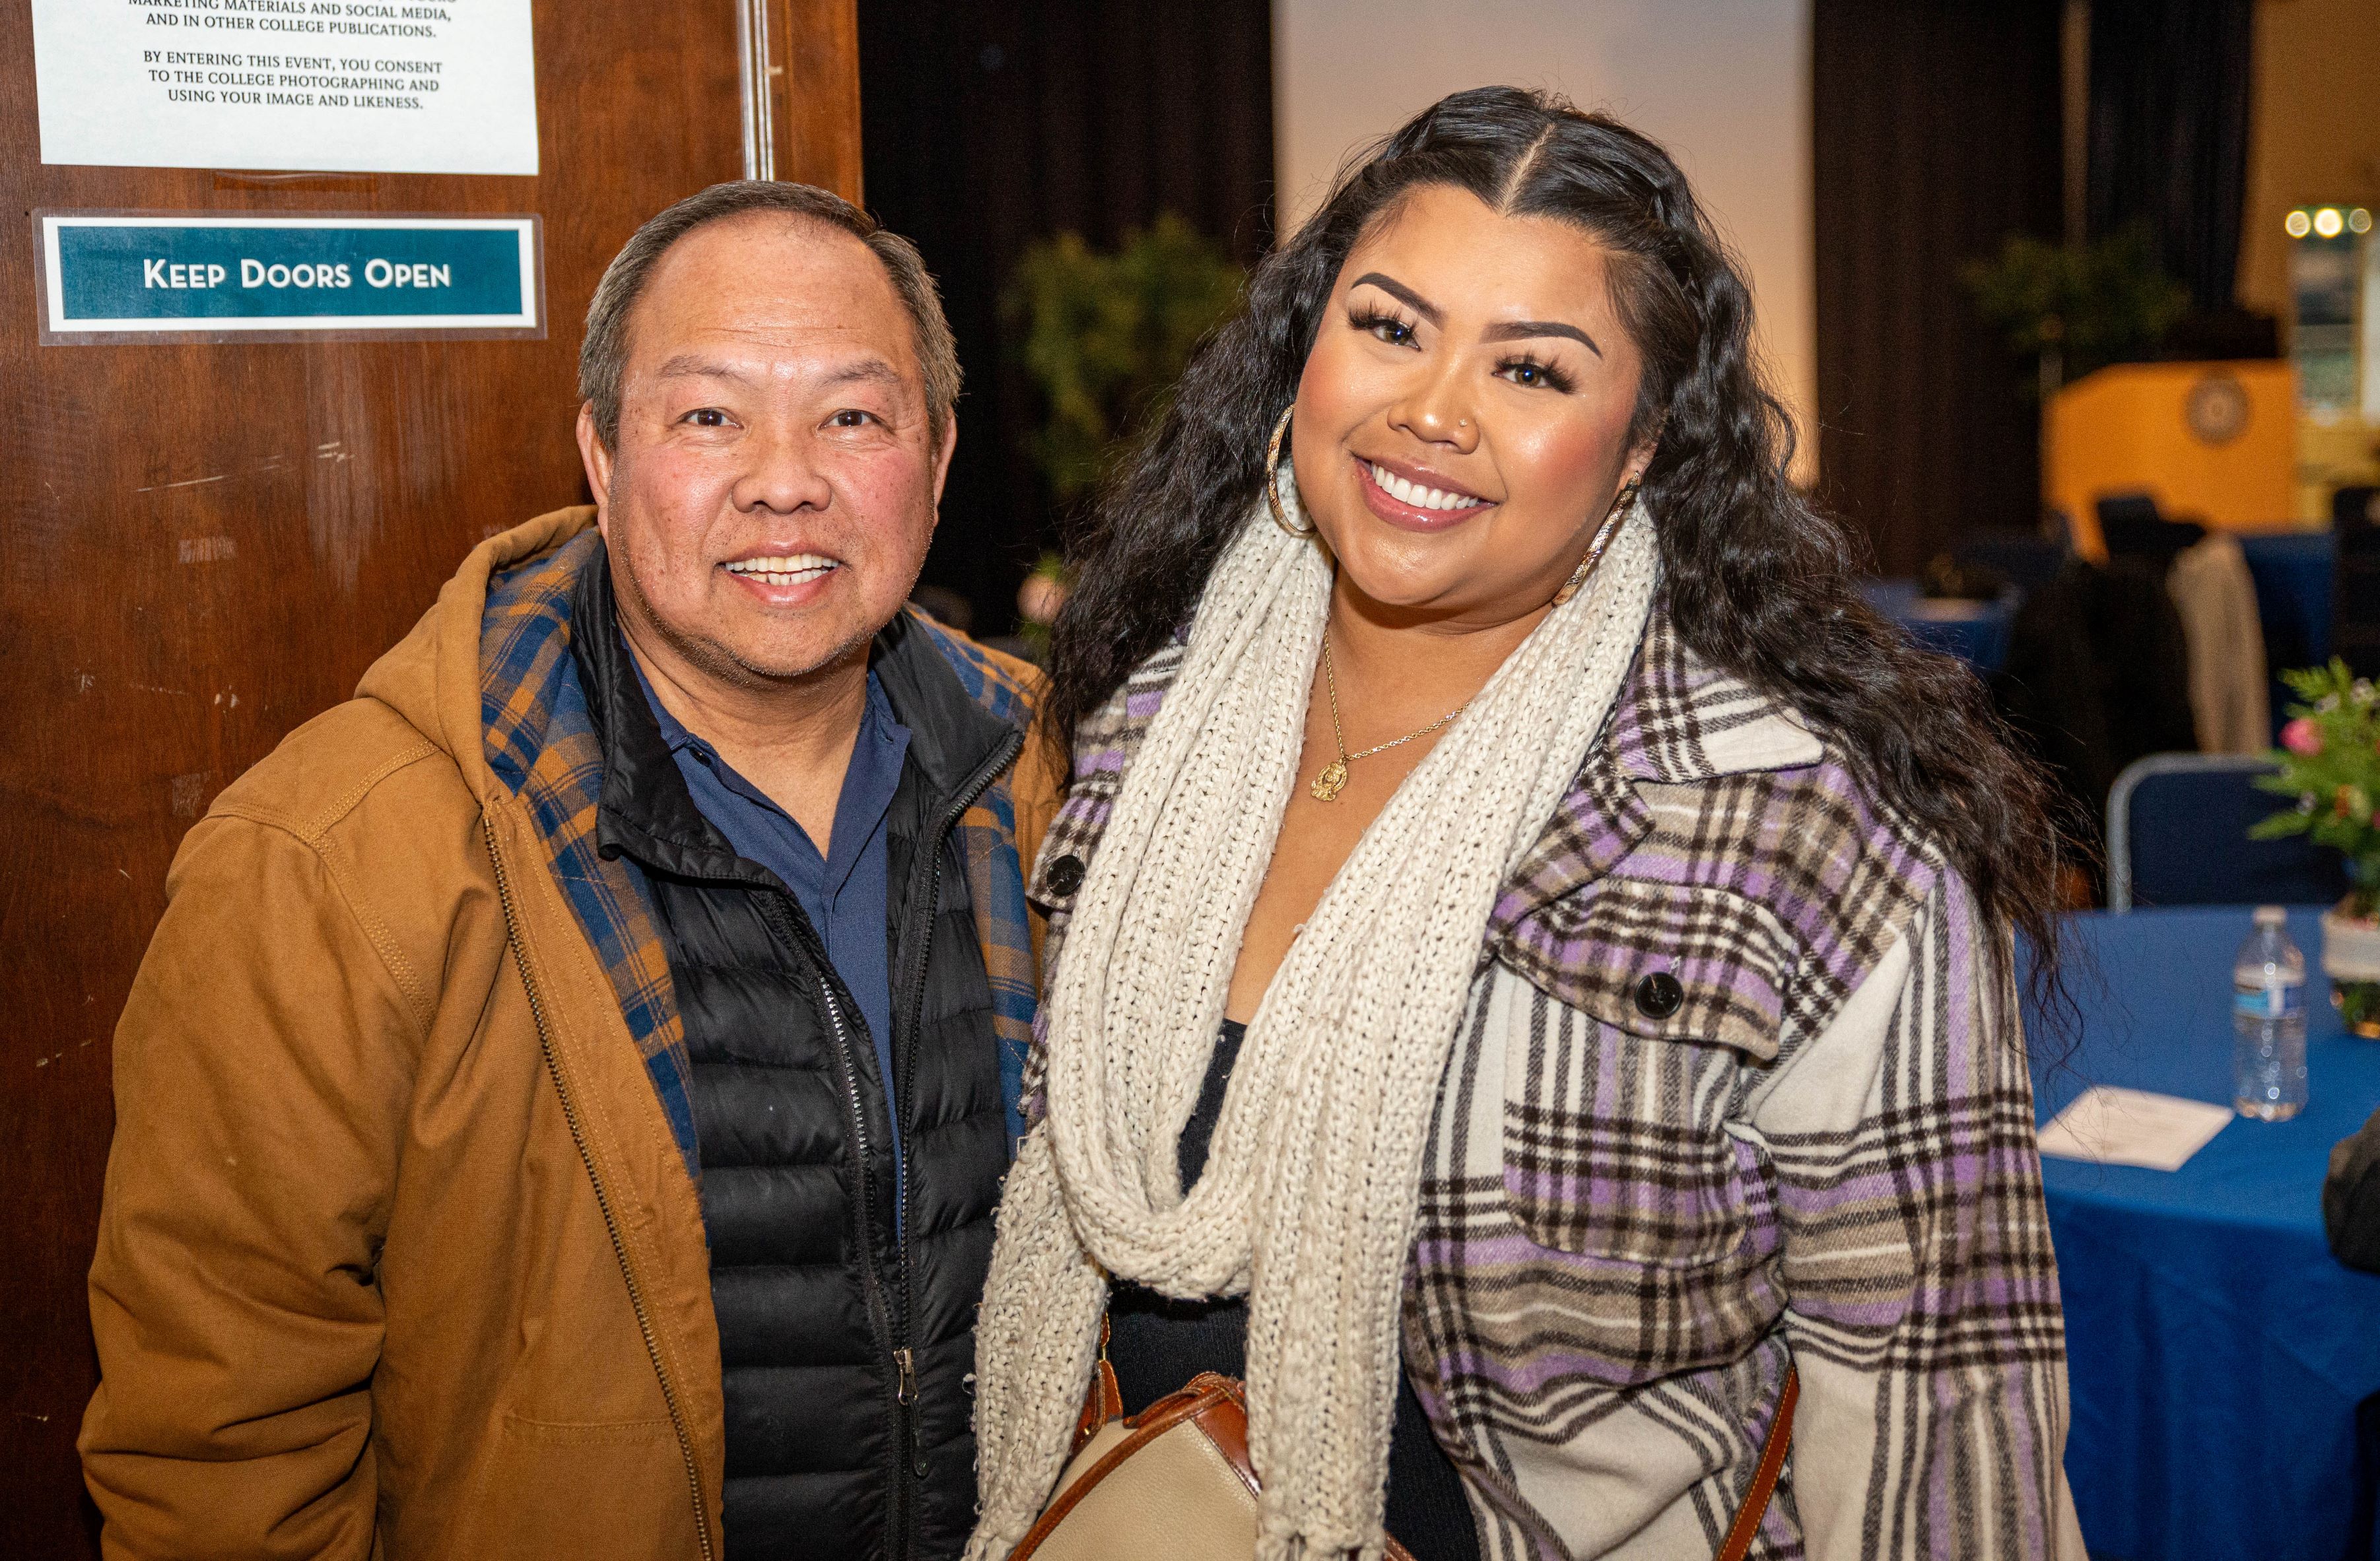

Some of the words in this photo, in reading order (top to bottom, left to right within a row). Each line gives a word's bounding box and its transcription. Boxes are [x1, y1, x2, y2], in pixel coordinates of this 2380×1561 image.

[224, 0, 306, 13] MATERIALS
[311, 3, 341, 15] AND
[345, 5, 396, 18] SOCIAL
[401, 7, 452, 22] MEDIA,
[146, 13, 178, 26] AND
[184, 15, 199, 27] IN
[204, 16, 255, 30] OTHER
[259, 18, 324, 32] COLLEGE
[329, 22, 436, 38] PUBLICATIONS.
[144, 50, 162, 63] BY
[166, 51, 243, 68] ENTERING
[246, 55, 281, 68] THIS
[285, 56, 336, 72] EVENT,
[339, 59, 371, 72] YOU
[374, 60, 443, 74] CONSENT
[149, 69, 171, 82] TO
[174, 71, 205, 84] THE
[208, 72, 275, 86] COLLEGE
[279, 75, 406, 91] PHOTOGRAPHING
[409, 80, 440, 92] AND
[168, 89, 217, 104] USING
[219, 91, 263, 104] YOUR
[265, 92, 315, 106] IMAGE
[318, 94, 351, 107] AND
[353, 96, 424, 110] LIKENESS.
